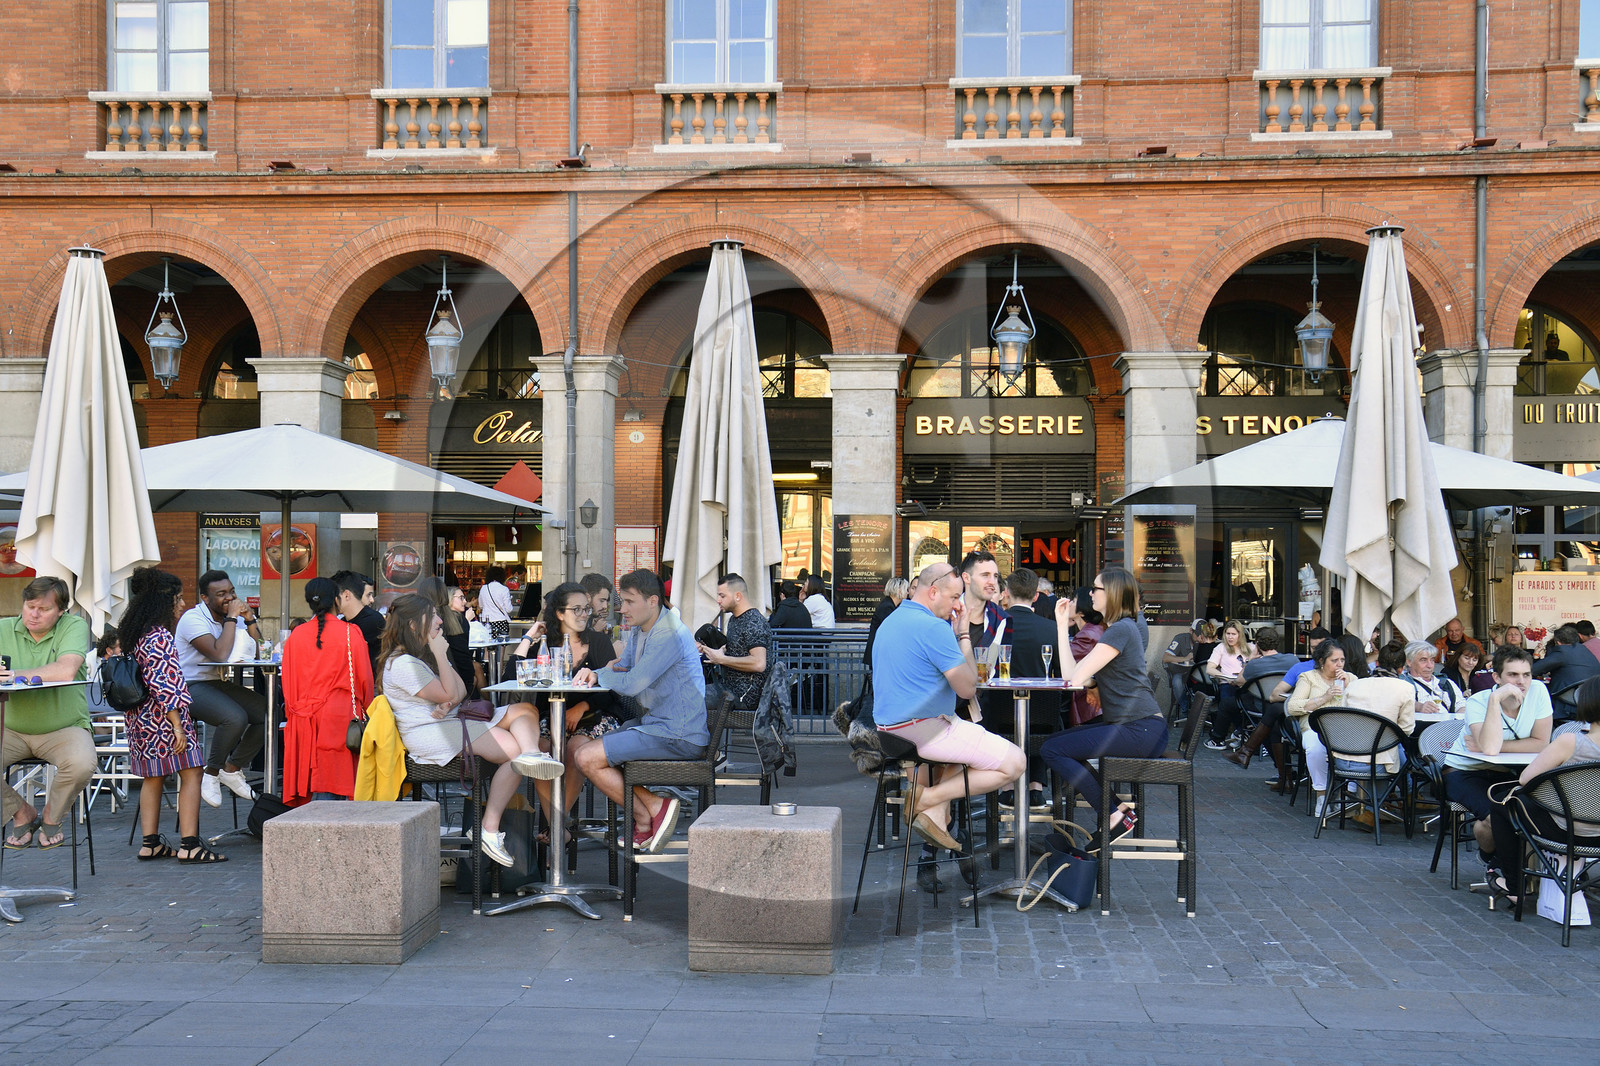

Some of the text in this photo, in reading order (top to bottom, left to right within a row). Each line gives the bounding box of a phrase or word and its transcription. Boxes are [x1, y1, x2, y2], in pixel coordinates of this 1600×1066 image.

[1524, 403, 1544, 423] DU
[473, 410, 543, 444] Octa
[916, 415, 1083, 435] BRASSERIE
[1222, 415, 1344, 435] TENO
[204, 517, 252, 526] ANALYSES
[1517, 580, 1596, 590] LE PARADIS S'EMPORTE
